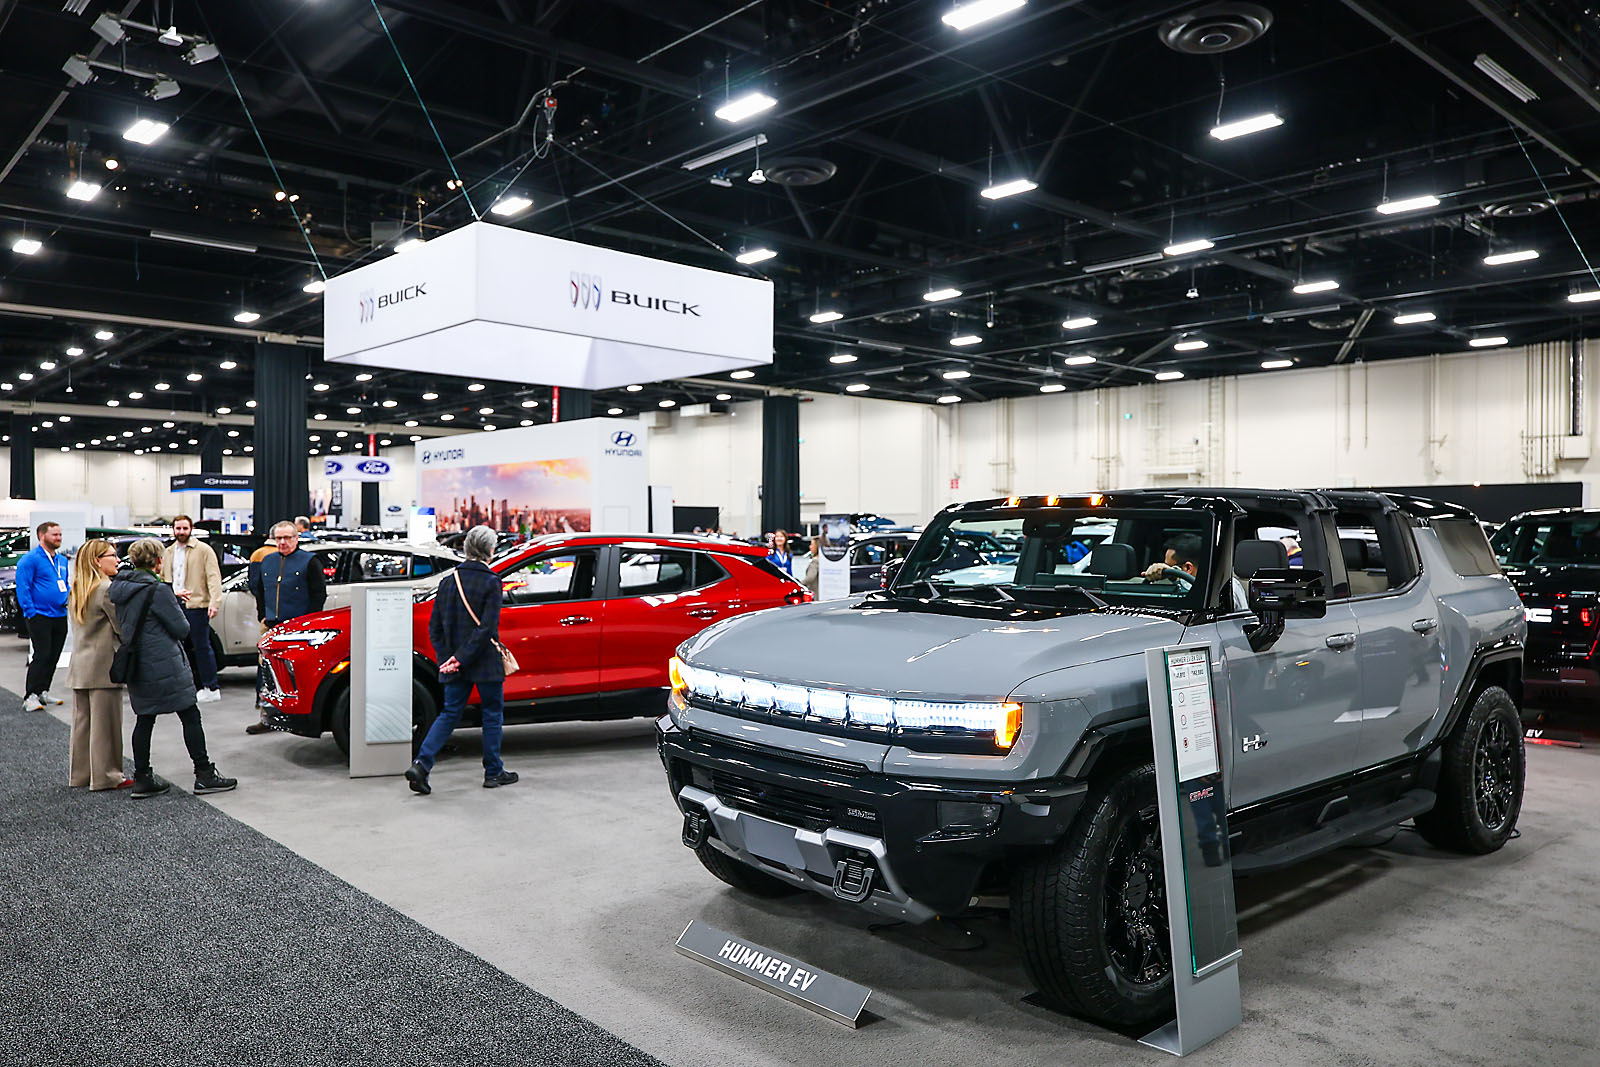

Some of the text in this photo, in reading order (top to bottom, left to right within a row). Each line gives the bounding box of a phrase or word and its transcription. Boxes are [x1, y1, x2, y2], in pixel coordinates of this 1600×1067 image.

[378, 282, 428, 309] BUICK
[611, 290, 701, 317] BUICK
[433, 448, 464, 461] HYUNDAI
[605, 449, 642, 457] HYUNDAI
[363, 461, 387, 473] Ford
[1525, 729, 1543, 738] EV
[1189, 786, 1214, 802] GMC
[847, 807, 876, 821] GMC
[718, 940, 818, 992] HUMMER EV
